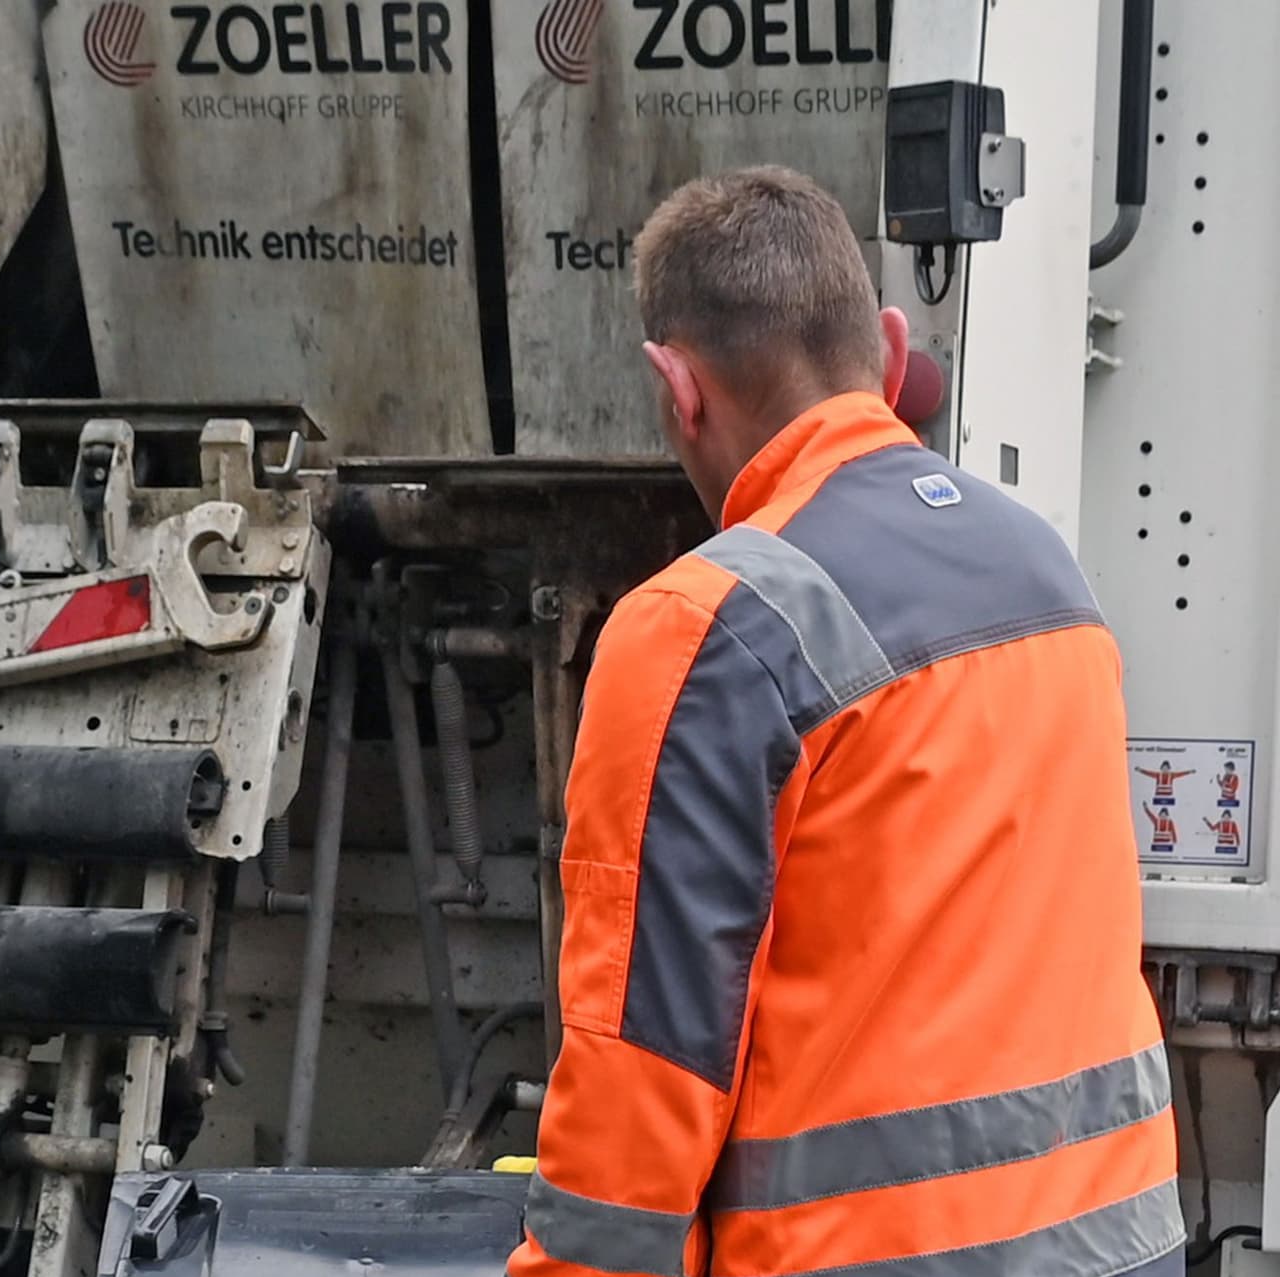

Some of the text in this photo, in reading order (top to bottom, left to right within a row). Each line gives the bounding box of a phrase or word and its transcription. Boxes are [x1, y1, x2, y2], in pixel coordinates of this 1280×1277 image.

[170, 2, 453, 75] ZOELLER
[181, 94, 405, 121] KIRCHHOFF GRUPPE
[634, 90, 782, 118] KIRCHHOFF
[112, 219, 458, 268] Technik entscheidet
